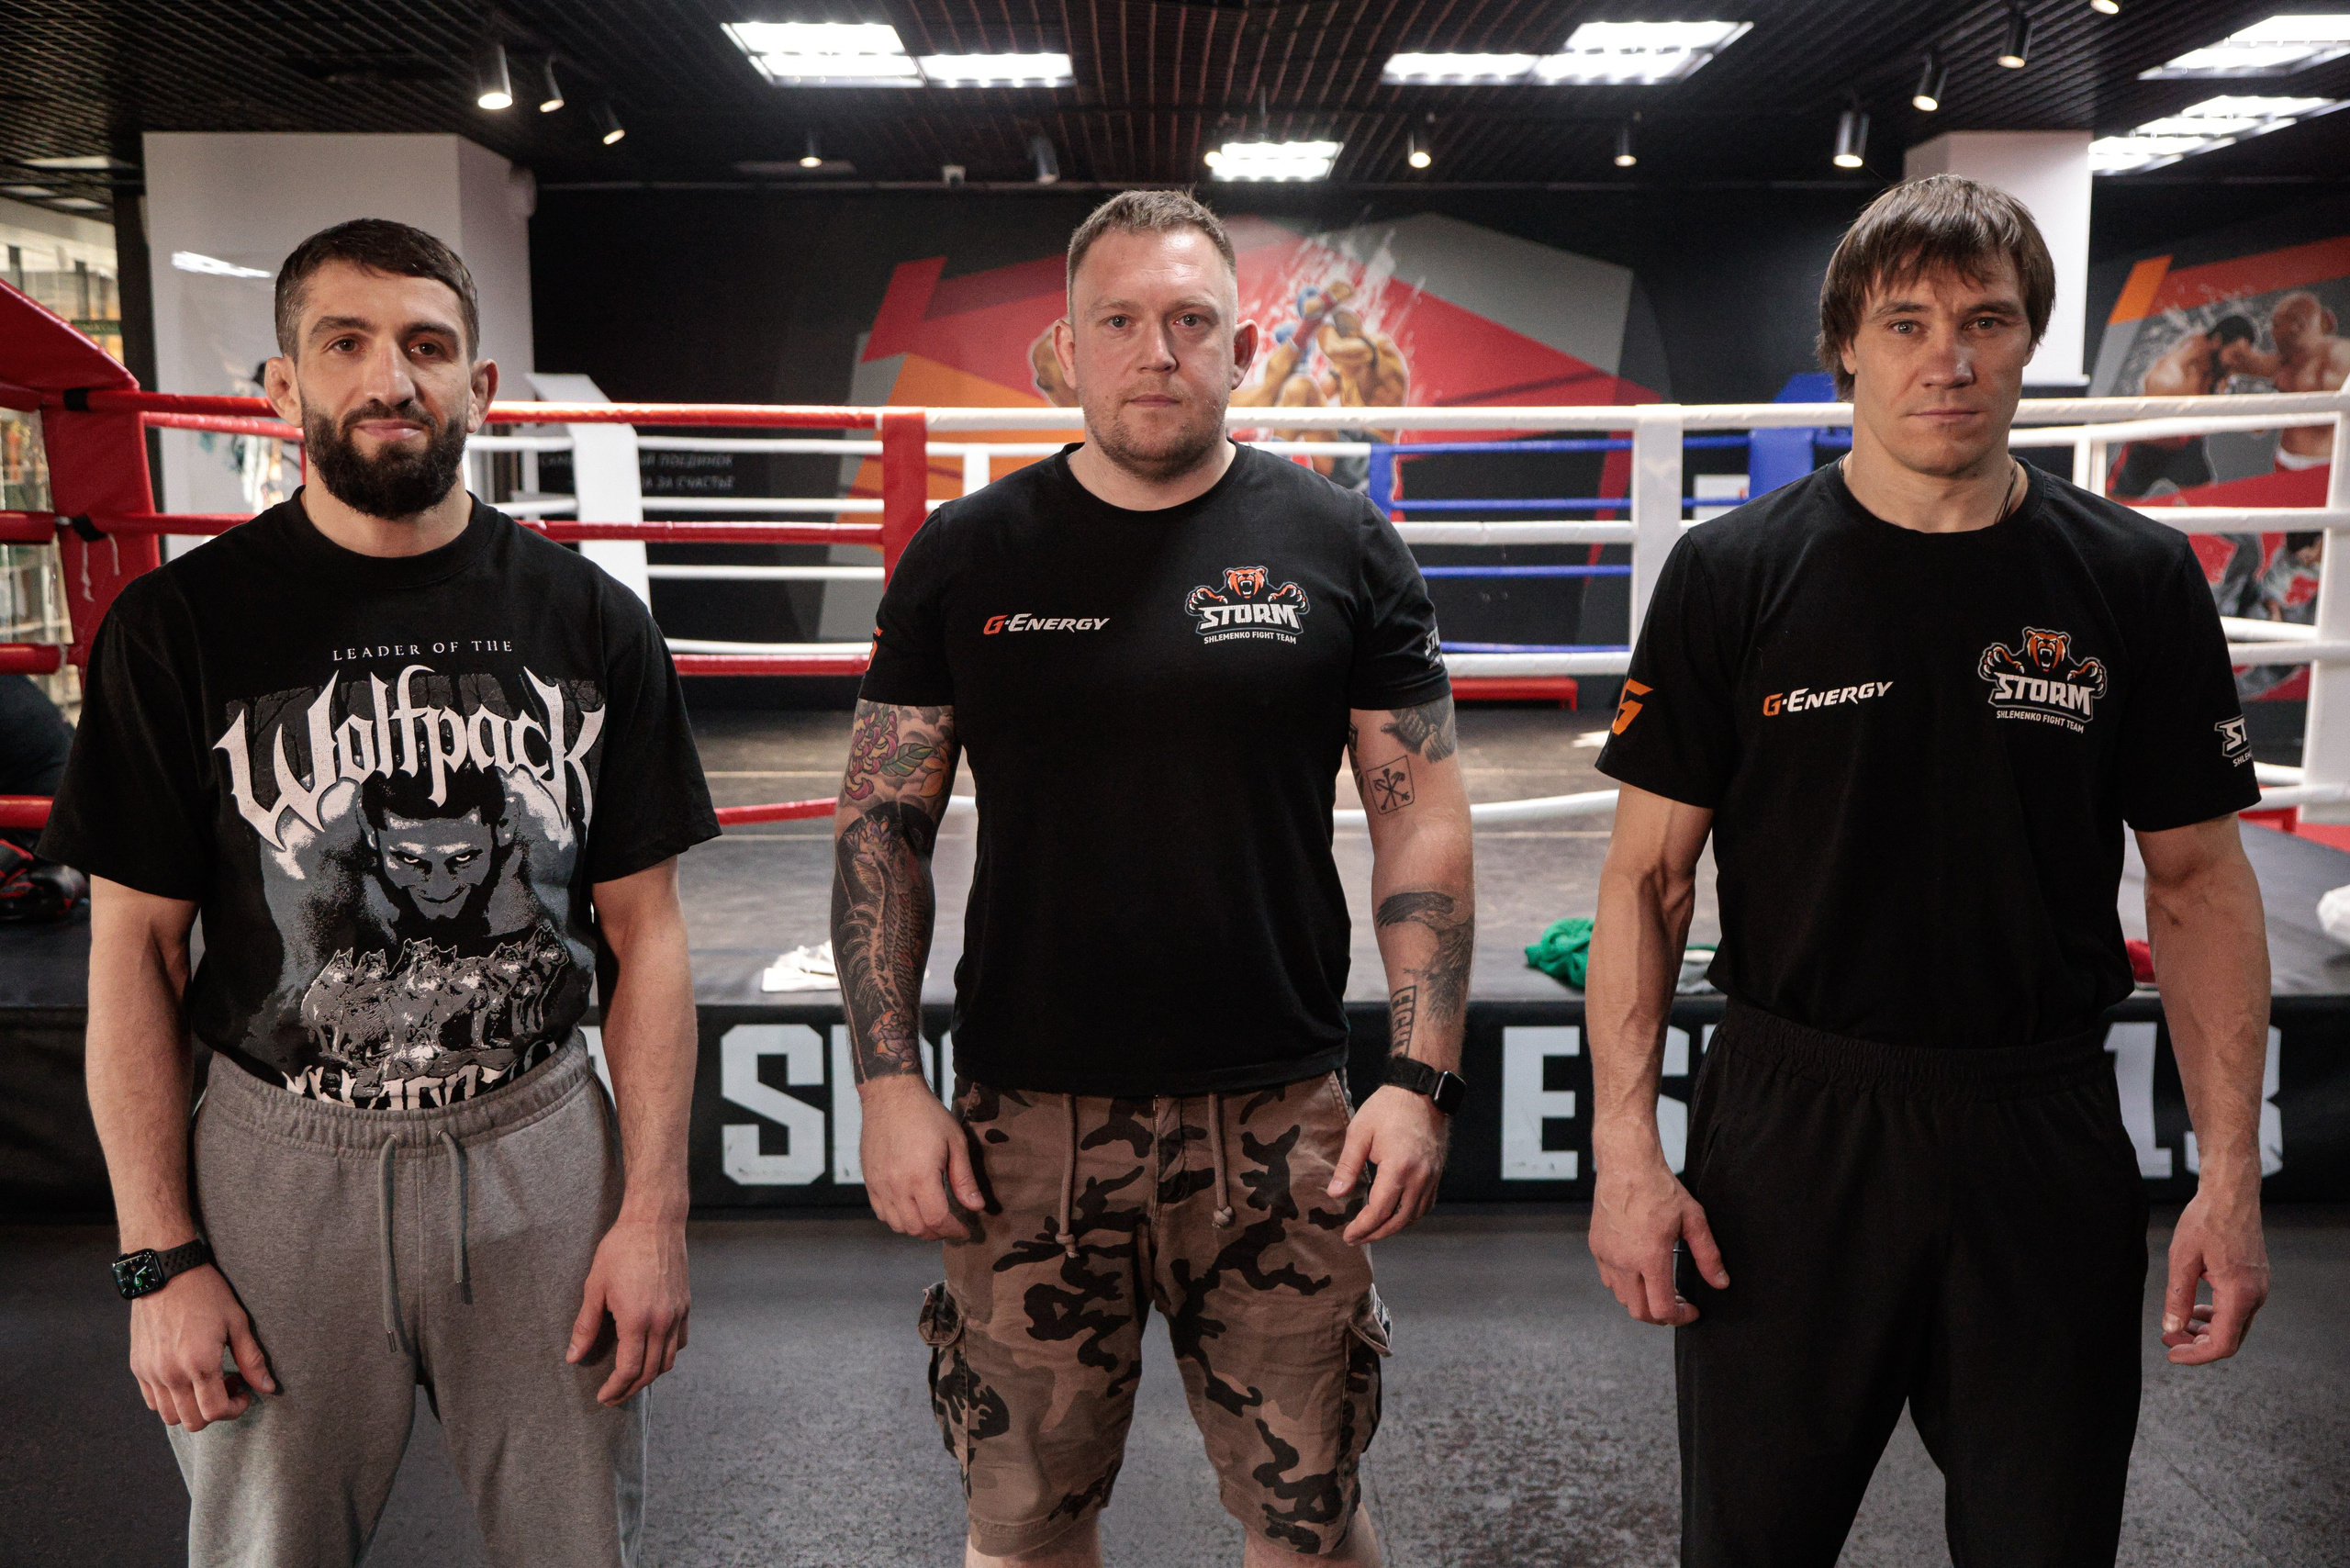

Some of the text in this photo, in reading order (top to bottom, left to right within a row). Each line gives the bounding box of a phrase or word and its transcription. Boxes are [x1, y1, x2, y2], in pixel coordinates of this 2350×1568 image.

[677, 476, 734, 489] СЧАСТЬЕ
[1198, 603, 1300, 630] STORM
[1203, 631, 1297, 644] SHLEMENKO FIGHT TEAM
[333, 641, 513, 661] LEADER OF THE
[1994, 672, 2096, 716] STORM
[1996, 710, 2085, 734] SHLEMENKO FIGHT TEAM
[212, 665, 606, 854] Wolfpack
